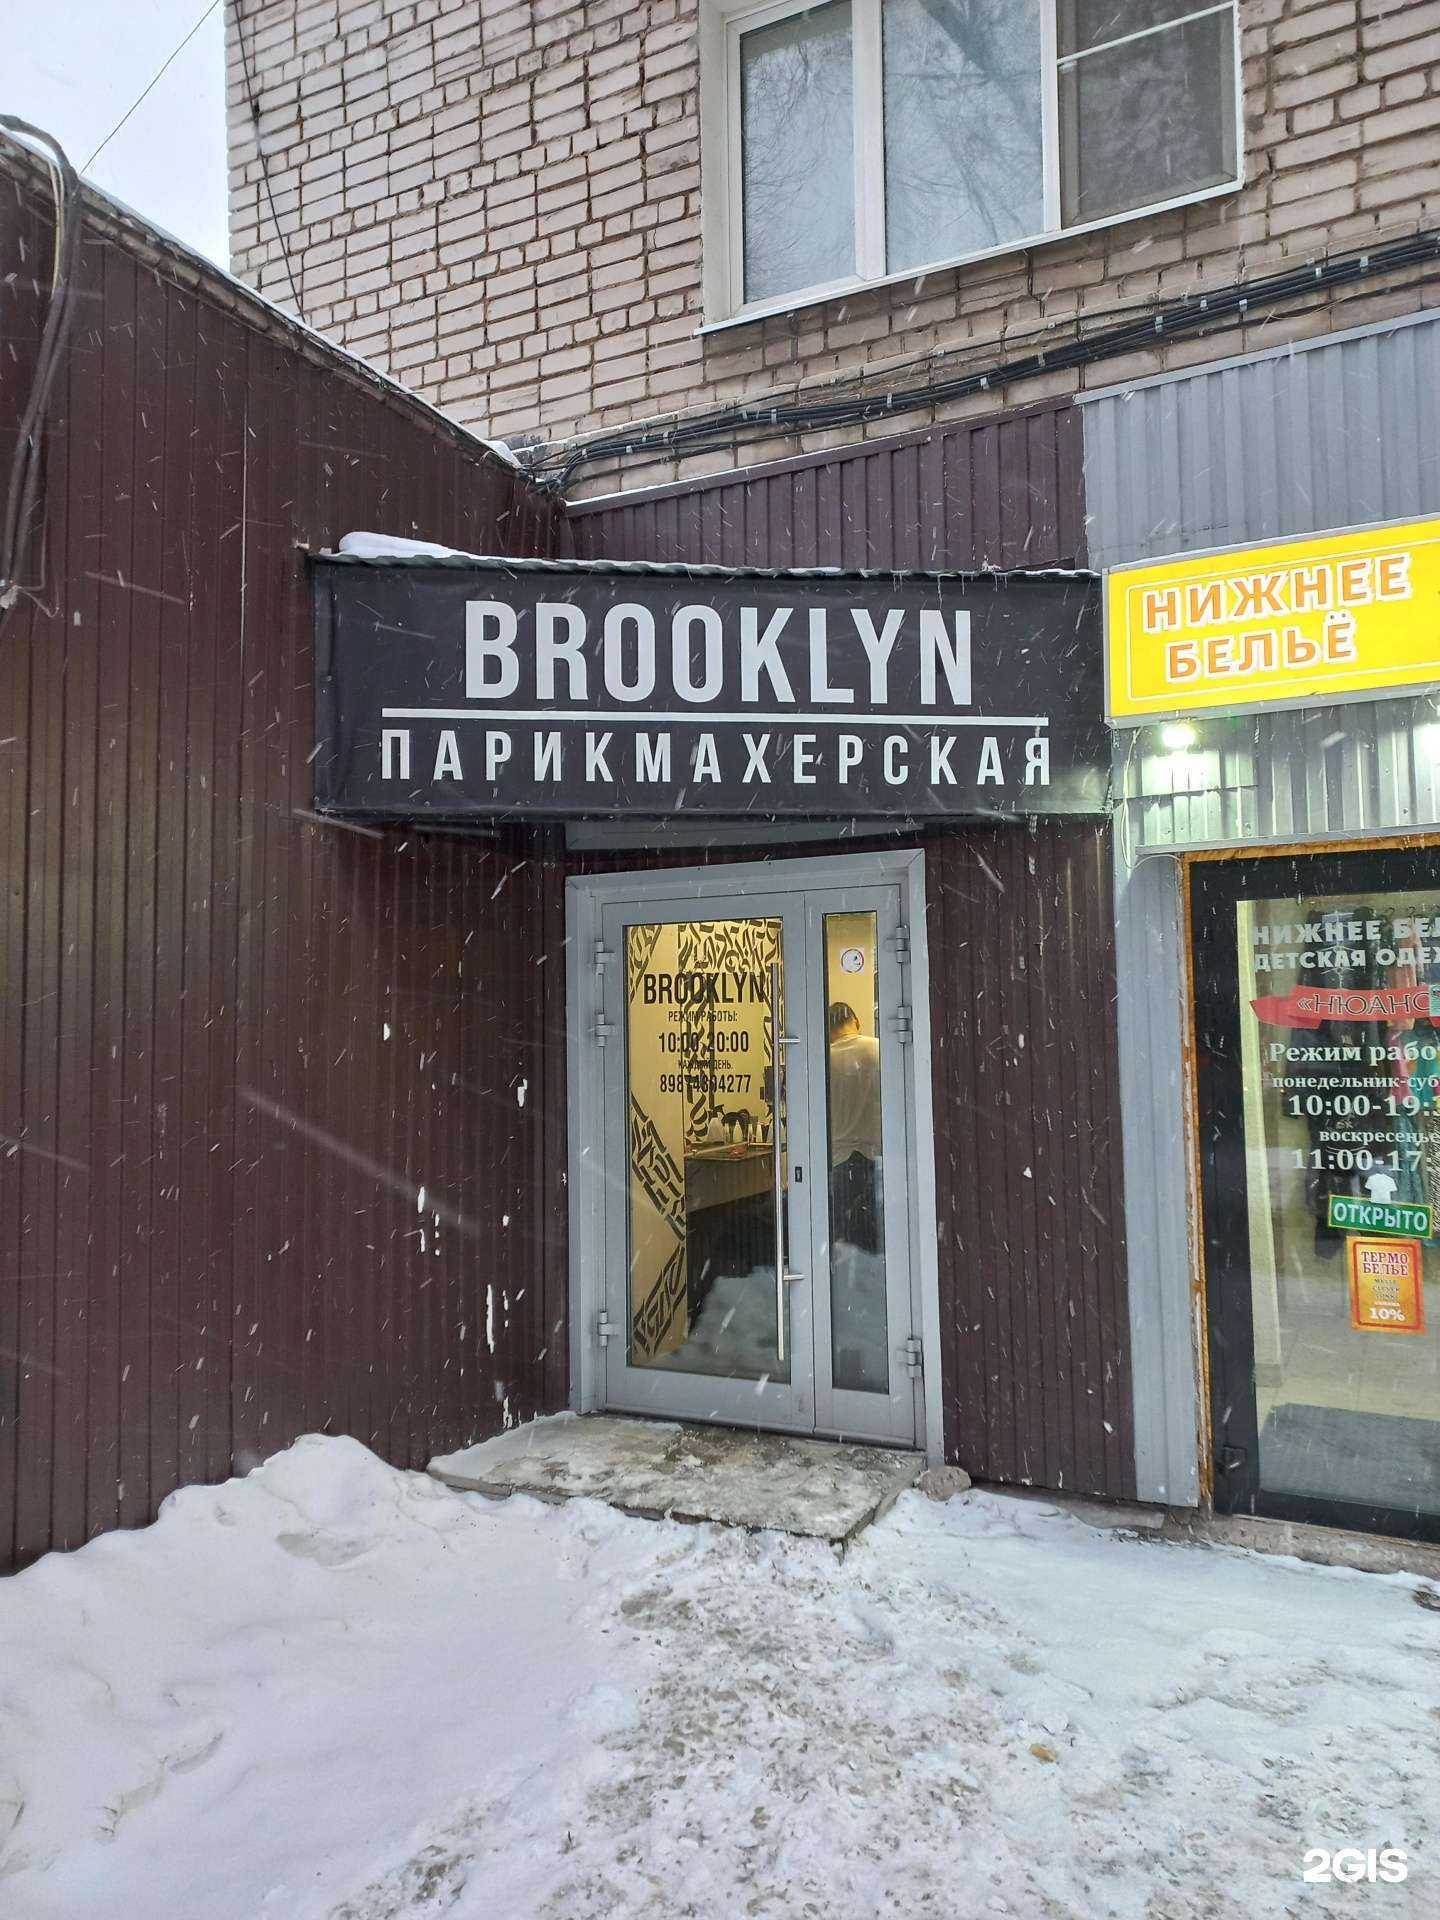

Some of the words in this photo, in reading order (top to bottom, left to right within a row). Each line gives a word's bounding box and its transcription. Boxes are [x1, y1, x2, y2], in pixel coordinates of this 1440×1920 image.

[1145, 555, 1407, 630] НИЖНЕЕ
[465, 599, 972, 706] BROOKLYN
[1168, 611, 1352, 680] БЕЛЬЁ
[380, 727, 1051, 786] ПАРИКМАХЕРСКАЯ
[1254, 920, 1382, 945] НИЖНЕЕ
[1254, 949, 1366, 972] ДЕТСКАЯ
[643, 972, 764, 1004] BROOKLYN
[1269, 1042, 1362, 1062] Режим
[1369, 1040, 1440, 1067] рабо
[1333, 1202, 1428, 1232] ОТКРЫТО
[1361, 1251, 1408, 1264] ТЕРМО
[1362, 1262, 1409, 1276] БЕЛЬЕ
[1369, 1306, 1406, 1322] 10%
